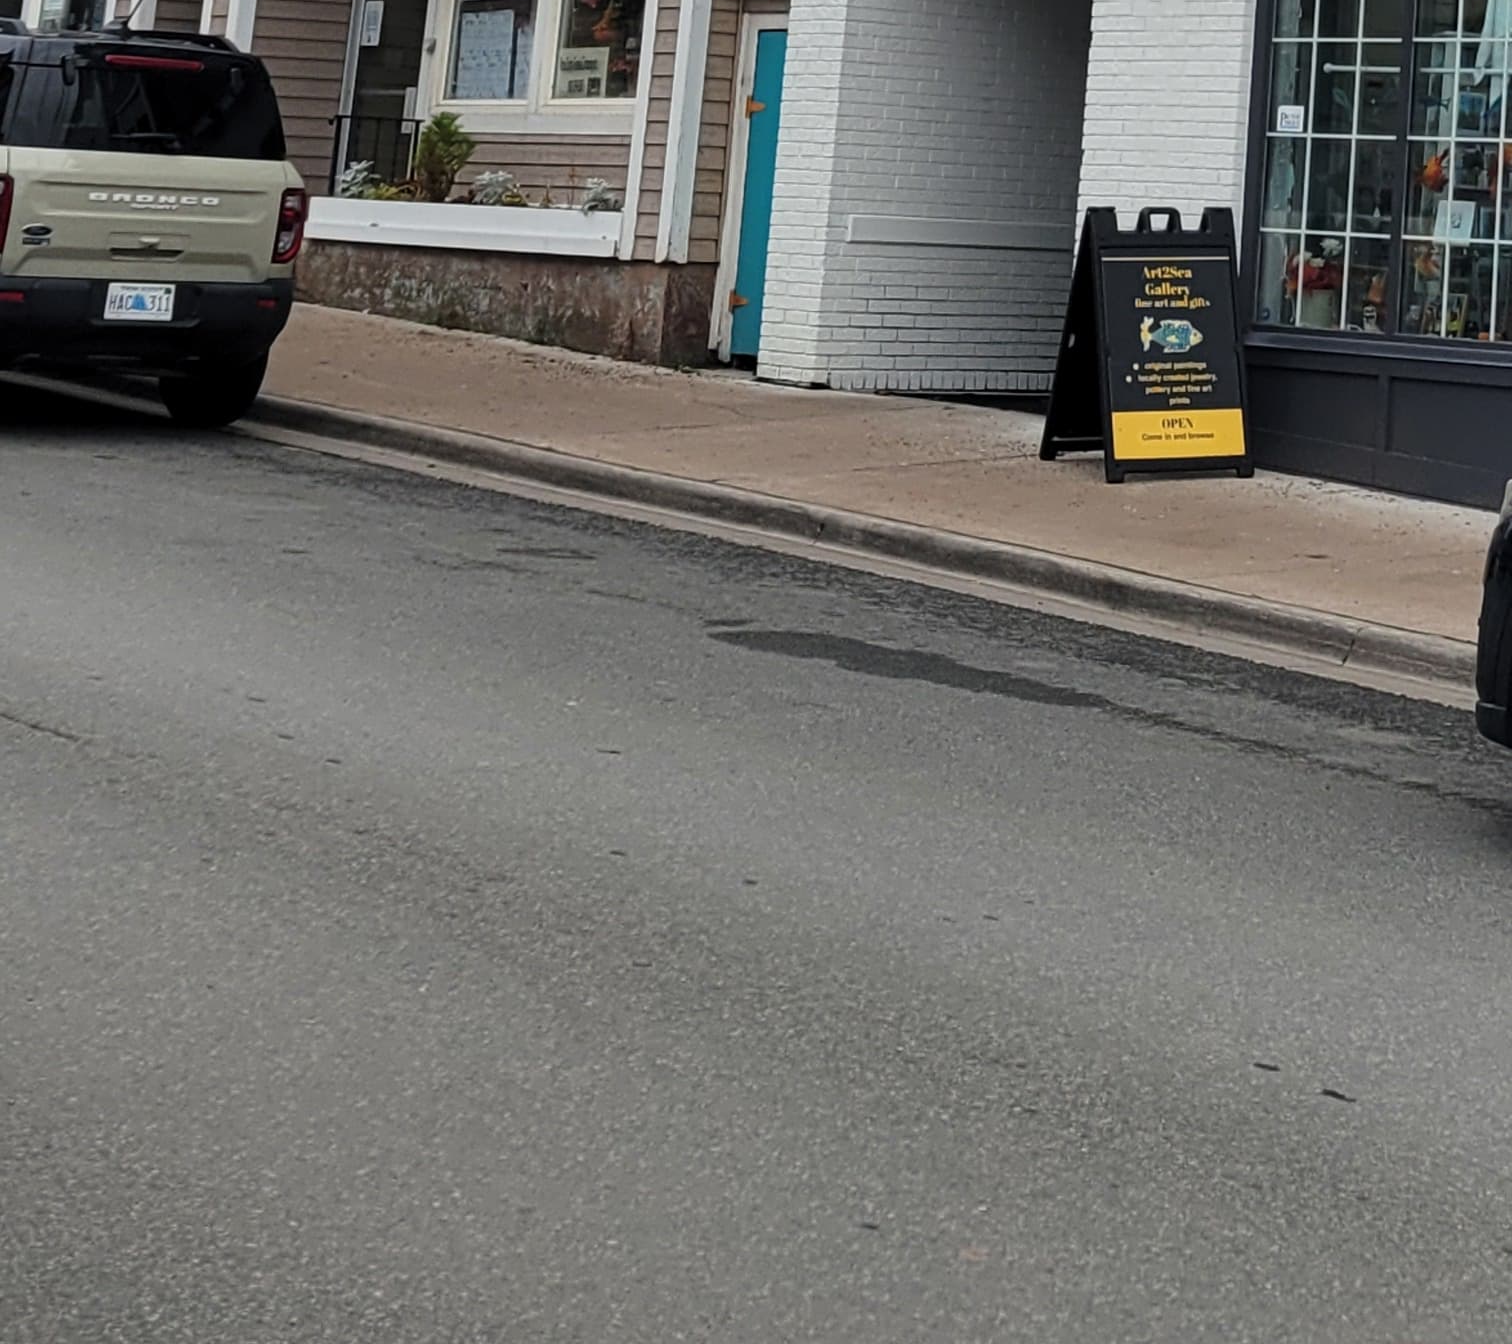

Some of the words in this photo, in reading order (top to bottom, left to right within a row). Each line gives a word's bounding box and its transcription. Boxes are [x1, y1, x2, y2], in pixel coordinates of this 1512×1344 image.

[1143, 266, 1192, 279] Art2Sea
[1145, 282, 1190, 296] Gallery
[149, 295, 169, 312] 311
[1162, 417, 1194, 429] OPEN
